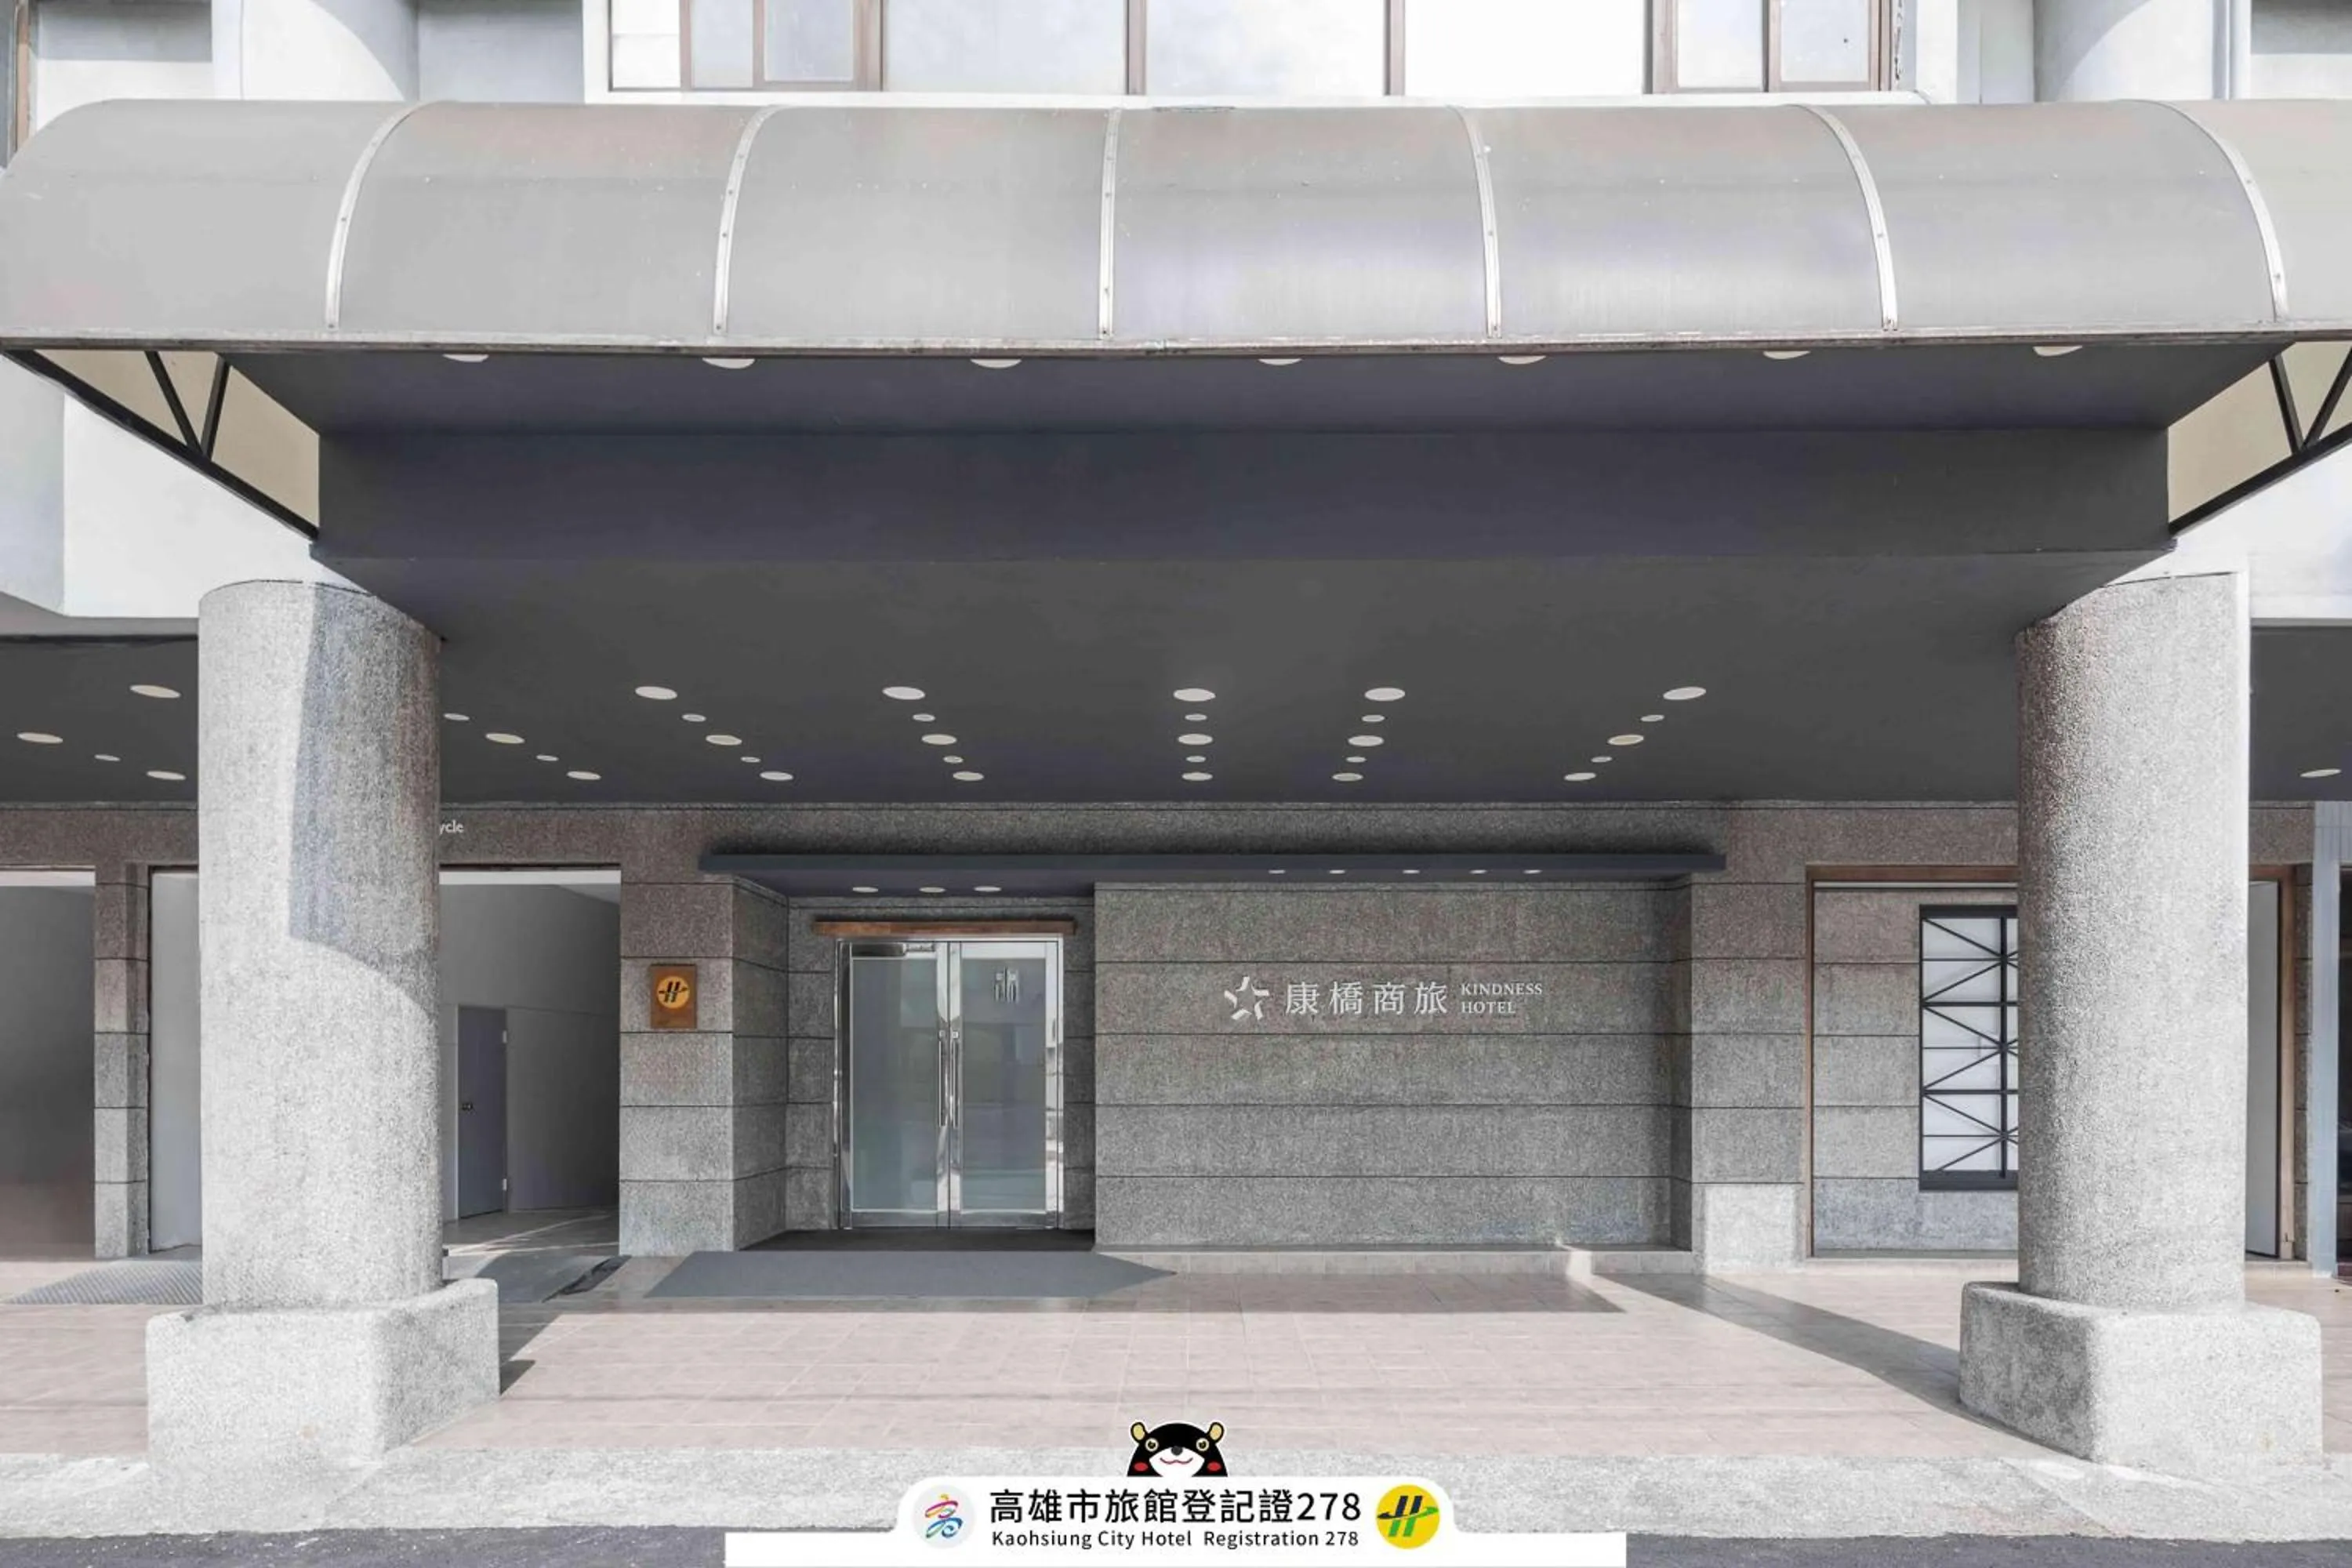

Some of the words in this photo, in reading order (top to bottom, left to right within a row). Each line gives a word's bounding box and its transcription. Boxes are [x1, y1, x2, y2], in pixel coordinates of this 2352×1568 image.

[1461, 982, 1543, 996] KINDNESS
[1285, 981, 1447, 1015] 康橋商旅
[1461, 1000, 1517, 1014] HOTEL
